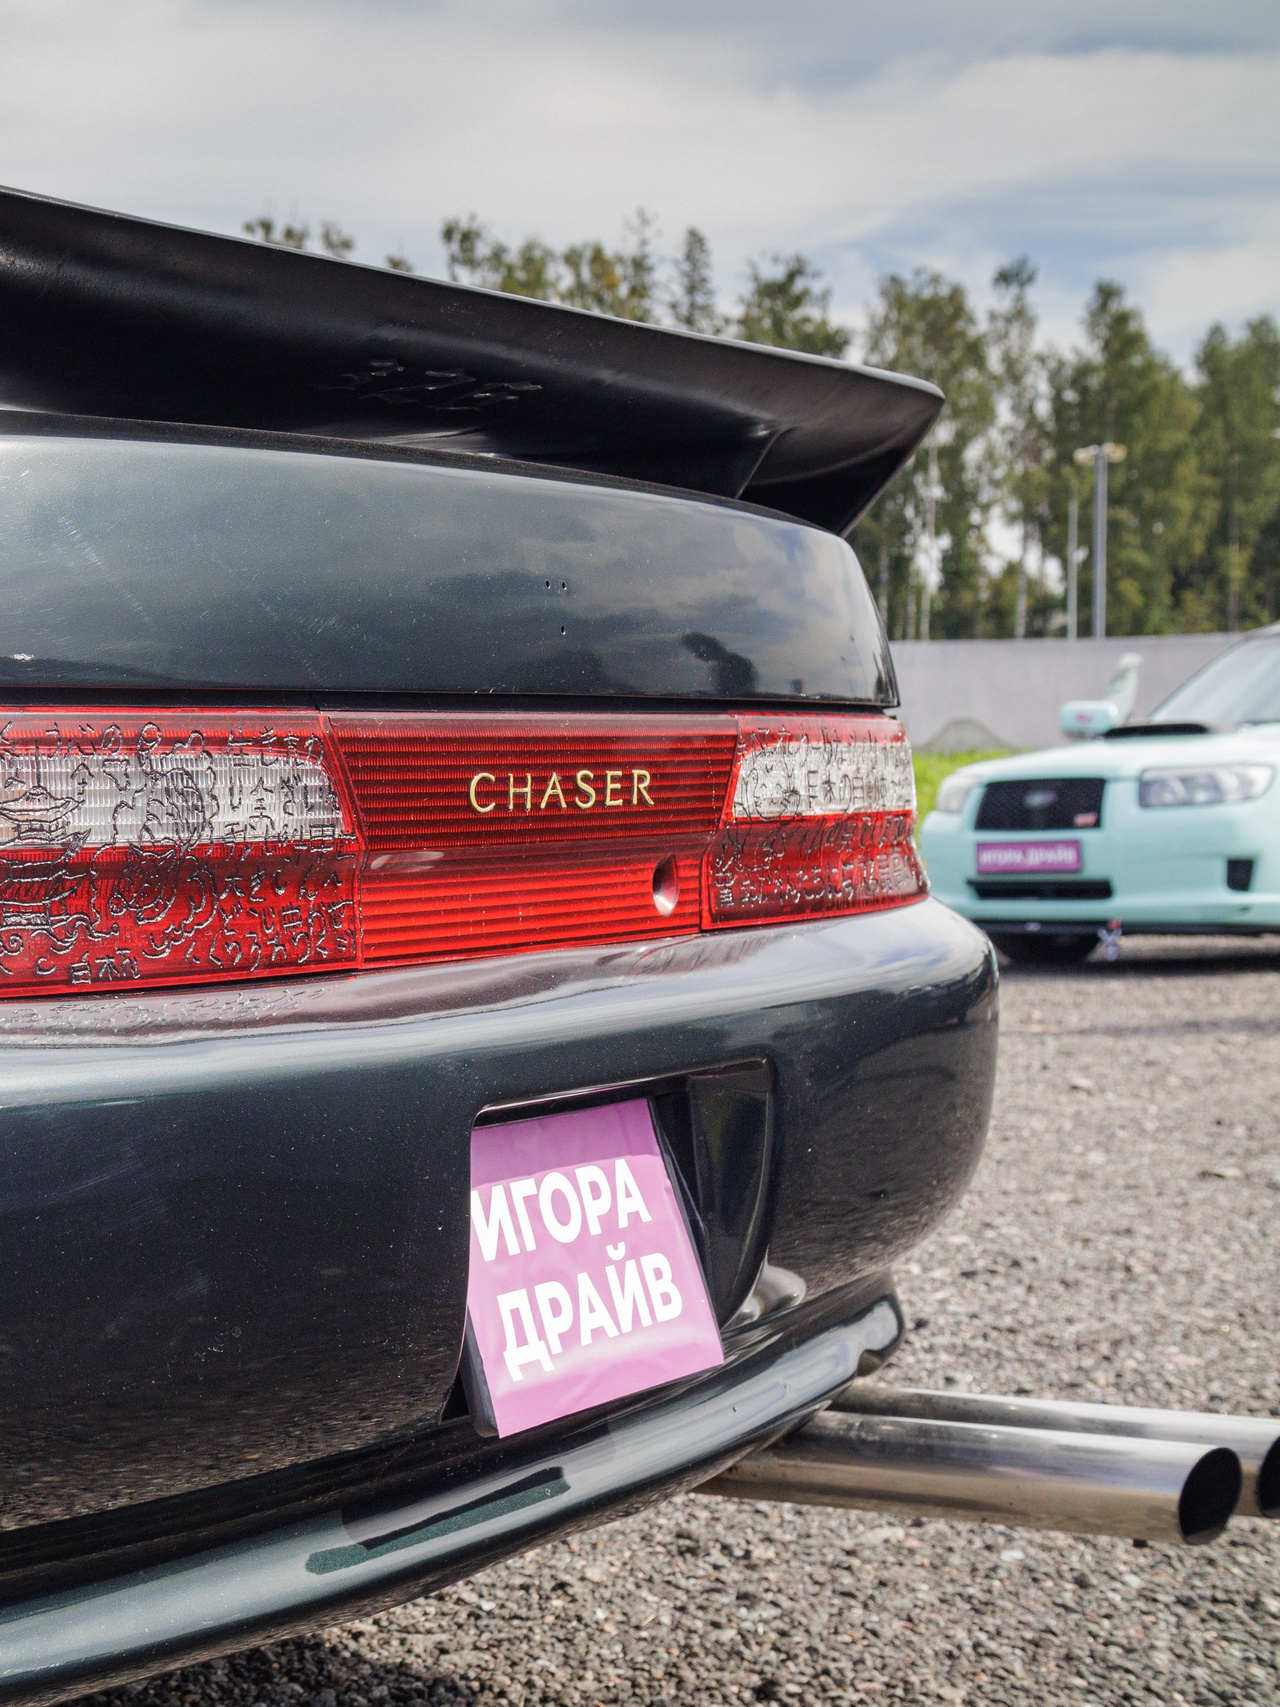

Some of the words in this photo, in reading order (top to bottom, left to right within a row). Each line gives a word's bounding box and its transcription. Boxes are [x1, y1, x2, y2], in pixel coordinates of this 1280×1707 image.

[470, 769, 655, 813] CHASER
[471, 1158, 653, 1263] ИГОРА
[496, 1241, 684, 1383] ДРАЙВ
